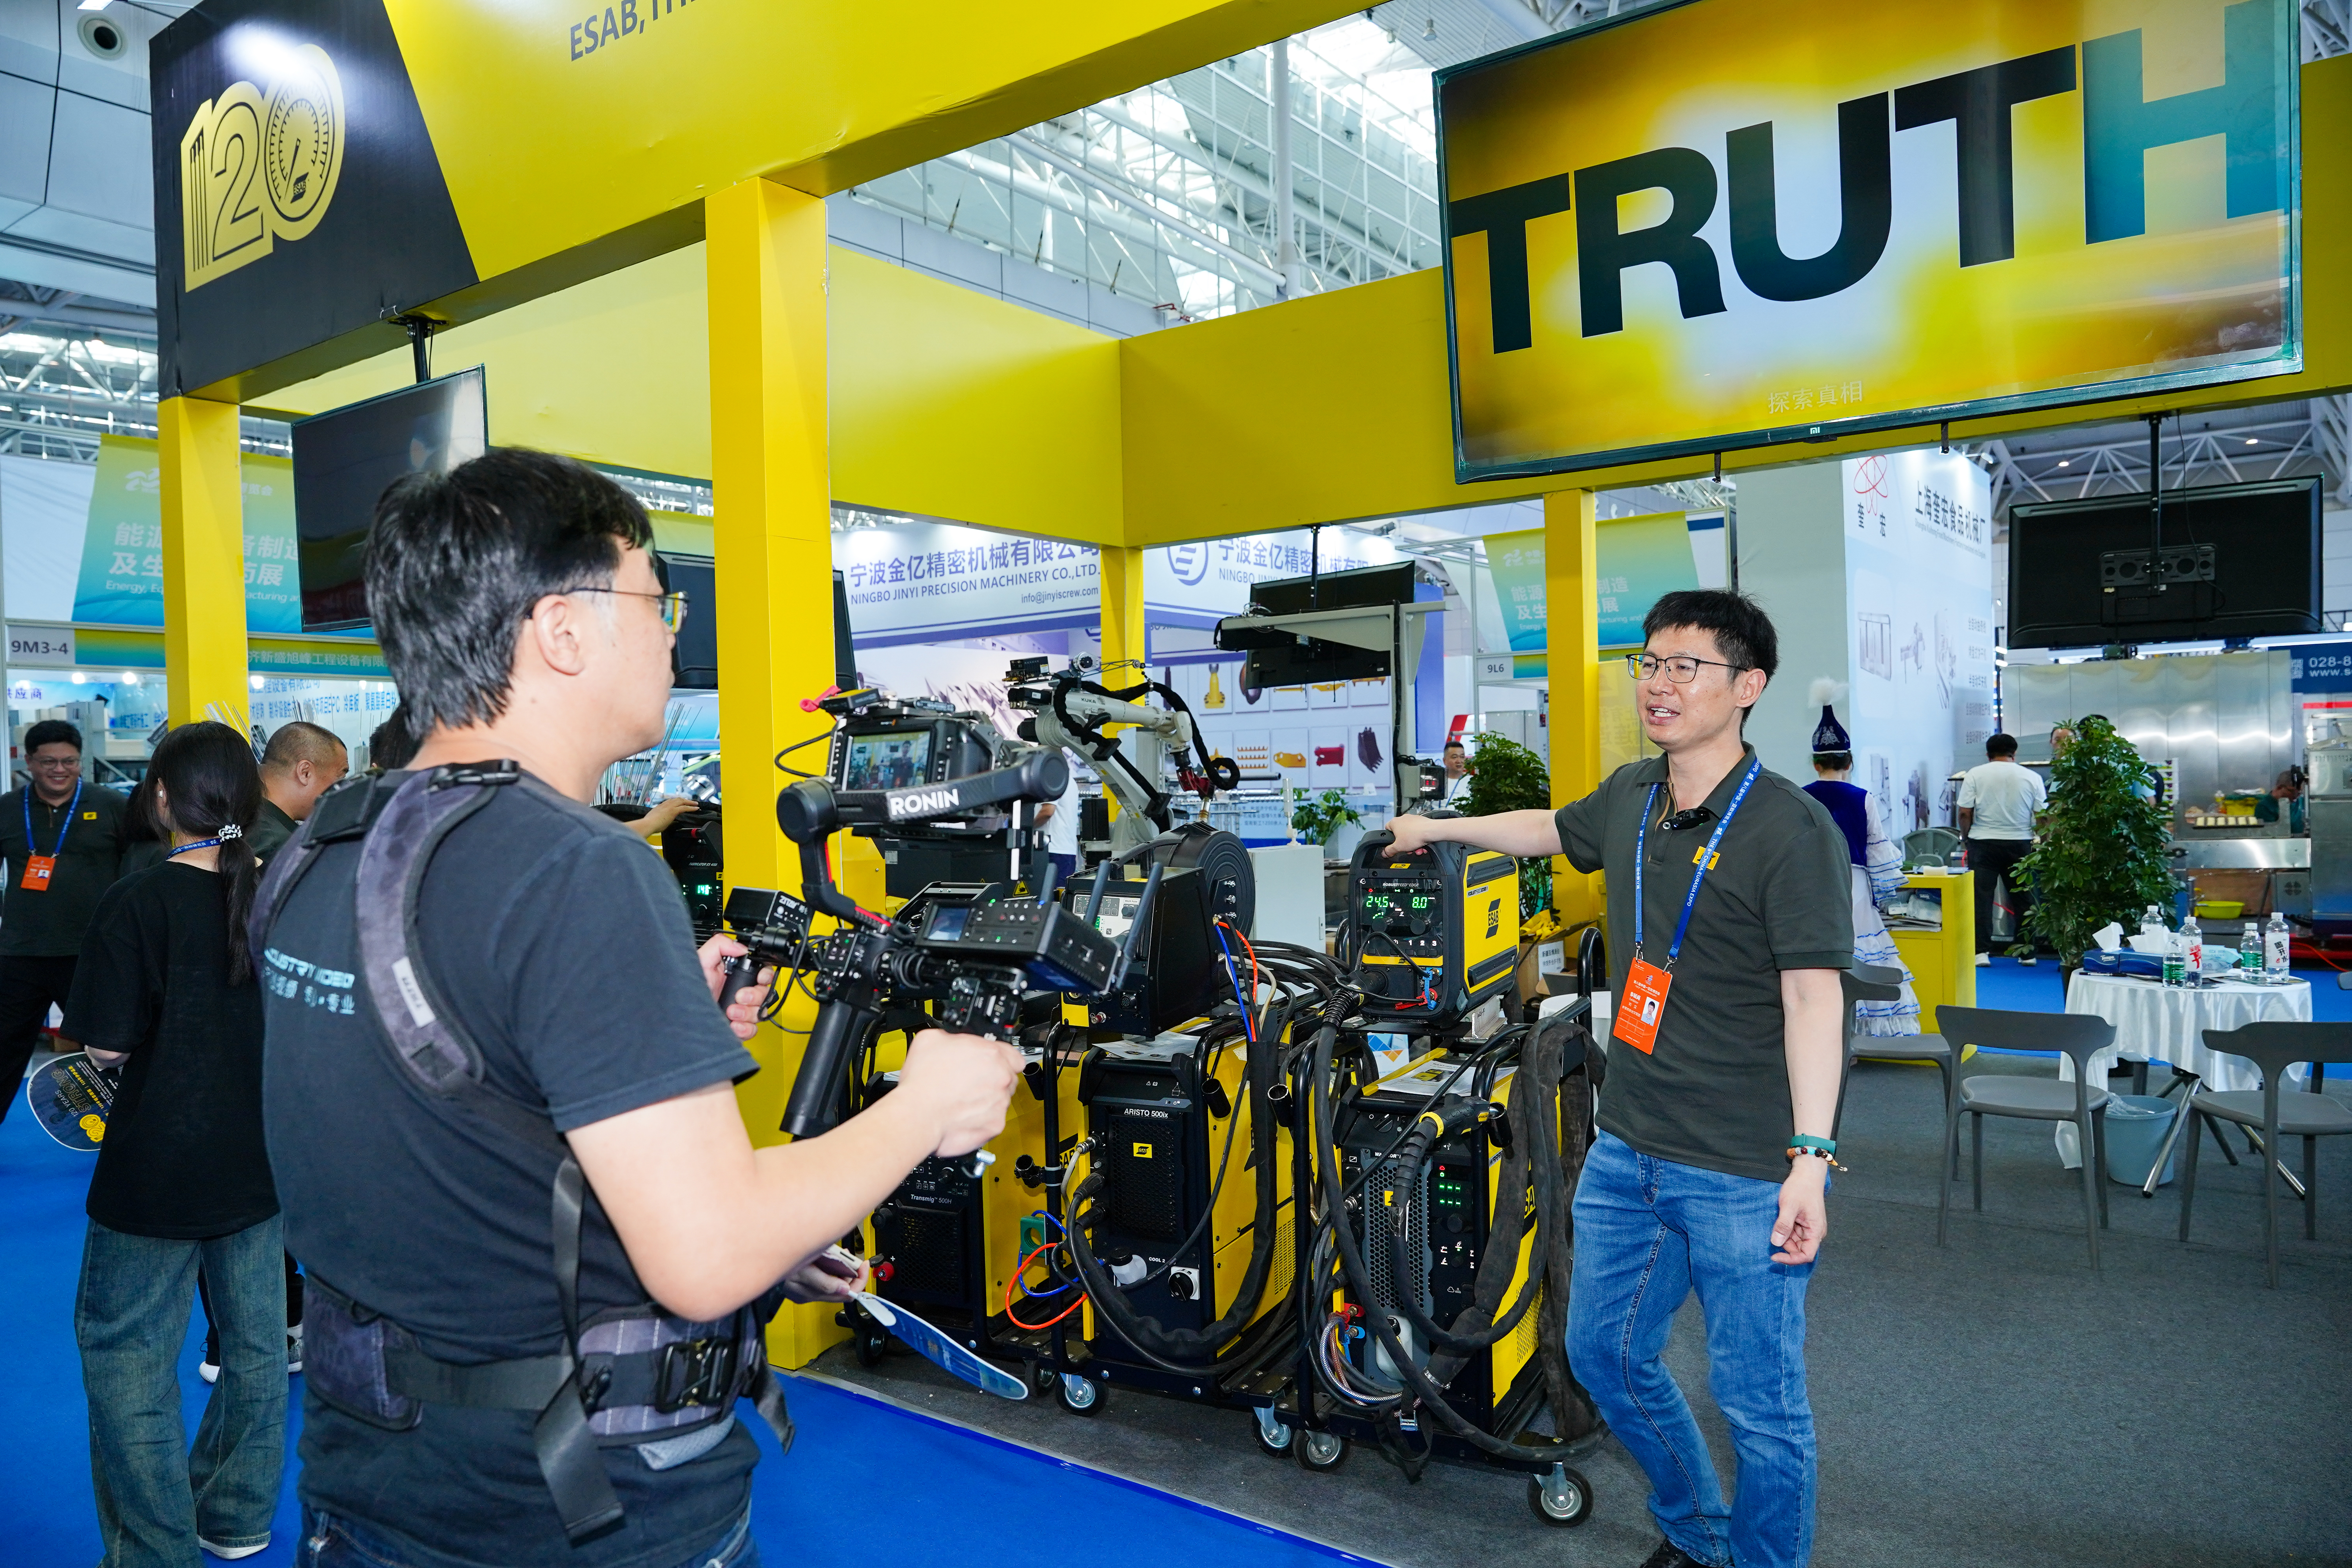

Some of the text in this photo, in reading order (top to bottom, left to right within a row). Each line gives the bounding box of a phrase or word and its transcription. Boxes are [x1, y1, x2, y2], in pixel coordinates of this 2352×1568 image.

[570, 0, 645, 62] ESAB,
[180, 44, 345, 292] 120
[1451, 2, 2290, 355] TRUTH
[1768, 381, 1862, 414] 探索真相
[851, 564, 1100, 604] NINGBO JINYI PRECISION MACHINERY CO.,LTD.
[1219, 568, 1254, 584] NINGBO
[106, 579, 147, 594] Energy,
[1022, 587, 1098, 604] info@jinyiscrew.com
[11, 640, 68, 655] 9M3-4
[1487, 663, 1504, 674] 9L6
[2308, 655, 2351, 668] 028-8
[2308, 668, 2352, 677] www.s
[890, 789, 960, 816] RONIN
[1138, 804, 1148, 821] KUKA
[1709, 838, 1718, 849] THE
[1690, 855, 1709, 893] CHINA-EURASIA
[1366, 896, 1388, 908] 24.5
[1412, 897, 1427, 908] 8.0
[1687, 893, 1695, 907] EXPO
[1488, 910, 1499, 926] ESAB
[1630, 991, 1641, 1001] 参展商
[51, 1068, 92, 1113] STRONG
[55, 1090, 79, 1117] 120 YEARS
[1124, 1108, 1168, 1118] ARISTO 500ix
